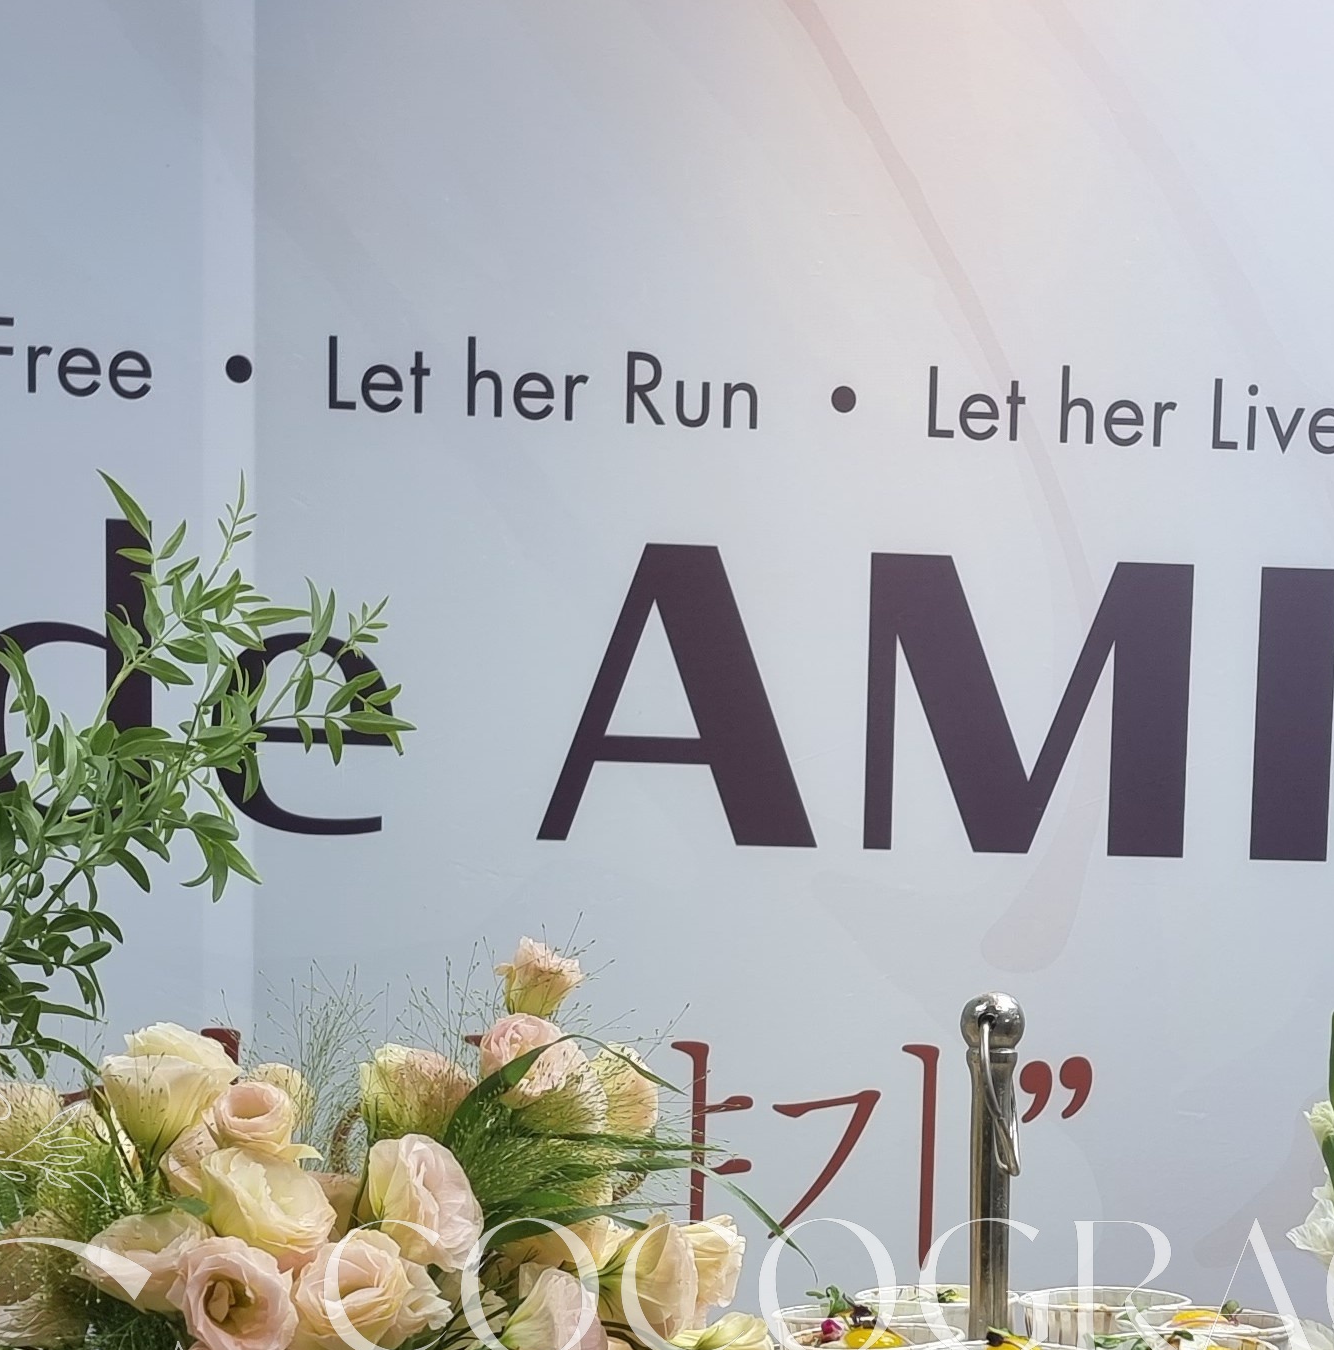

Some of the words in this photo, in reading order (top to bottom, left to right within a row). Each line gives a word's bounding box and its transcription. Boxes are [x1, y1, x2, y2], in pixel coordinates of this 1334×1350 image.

[328, 335, 431, 414] Let
[467, 336, 589, 421] her
[624, 350, 760, 430] Run
[927, 366, 1027, 441] Let
[1059, 365, 1178, 447] her
